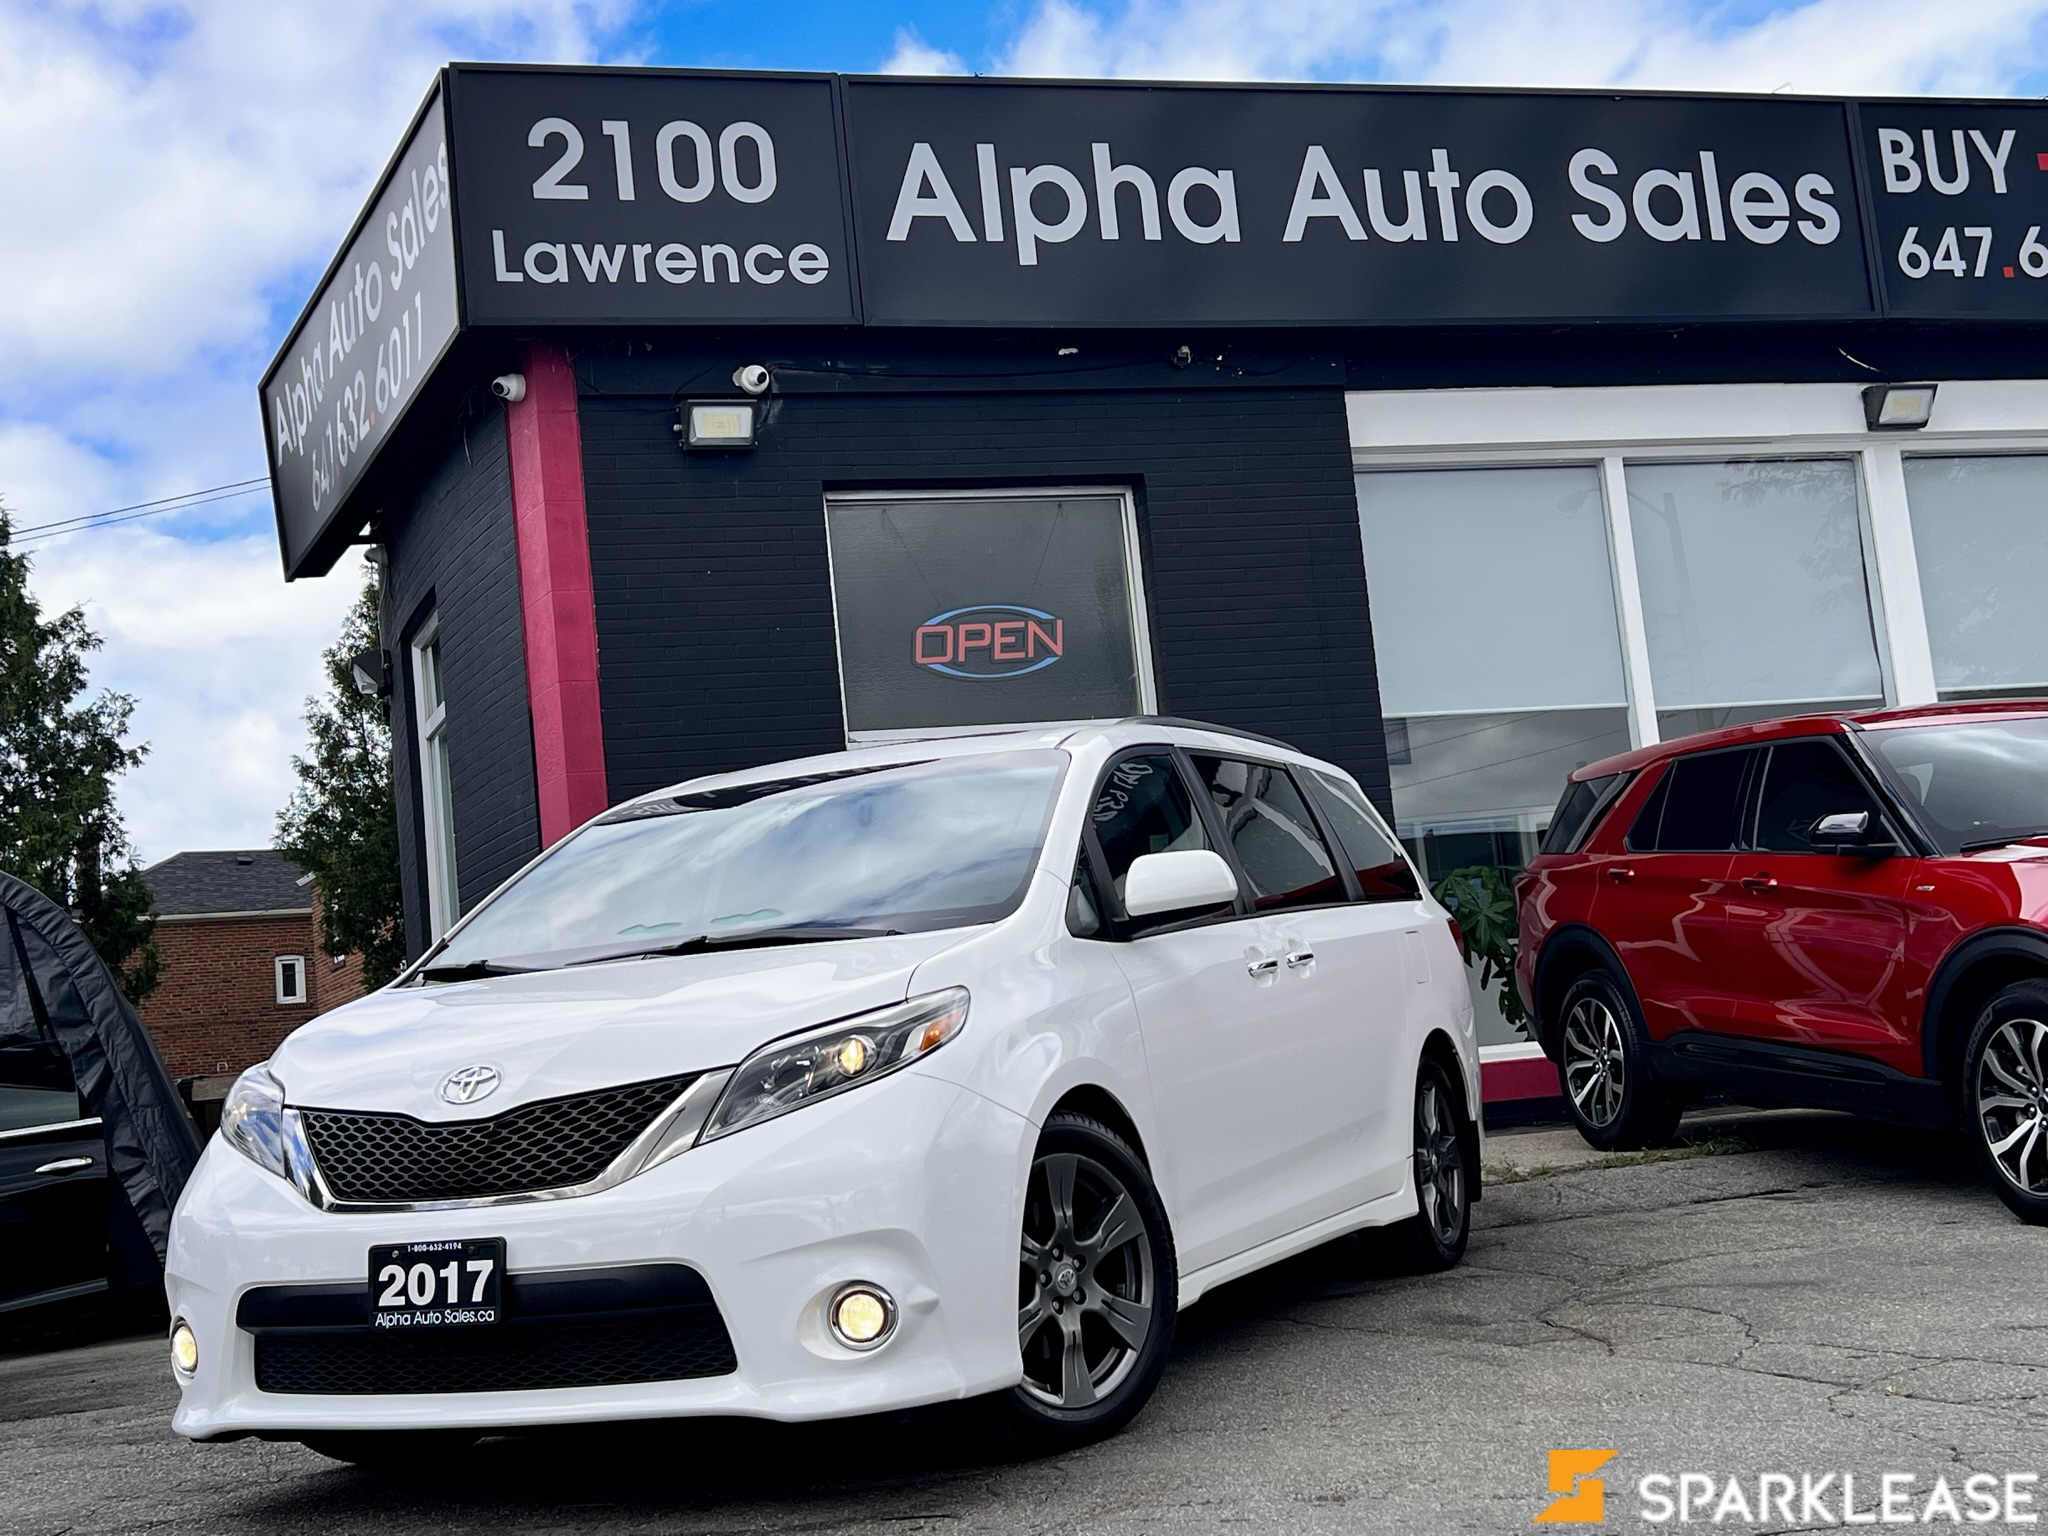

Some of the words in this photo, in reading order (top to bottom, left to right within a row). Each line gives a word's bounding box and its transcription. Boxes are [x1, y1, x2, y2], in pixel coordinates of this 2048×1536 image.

[527, 117, 778, 204] 2100
[1878, 128, 2016, 195] BUY
[886, 142, 1241, 265] Alpha
[1282, 145, 1534, 245] Auto
[1567, 147, 1841, 245] Sales
[491, 230, 830, 285] Lawrence
[274, 341, 325, 467] Alpha
[328, 260, 383, 379] Auto
[386, 141, 449, 291] Sales
[915, 618, 1064, 664] OPEN
[378, 1259, 494, 1307] 2017
[375, 1311, 411, 1329] Alpha
[413, 1311, 442, 1325] Auto
[444, 1309, 495, 1324] Sales.ca
